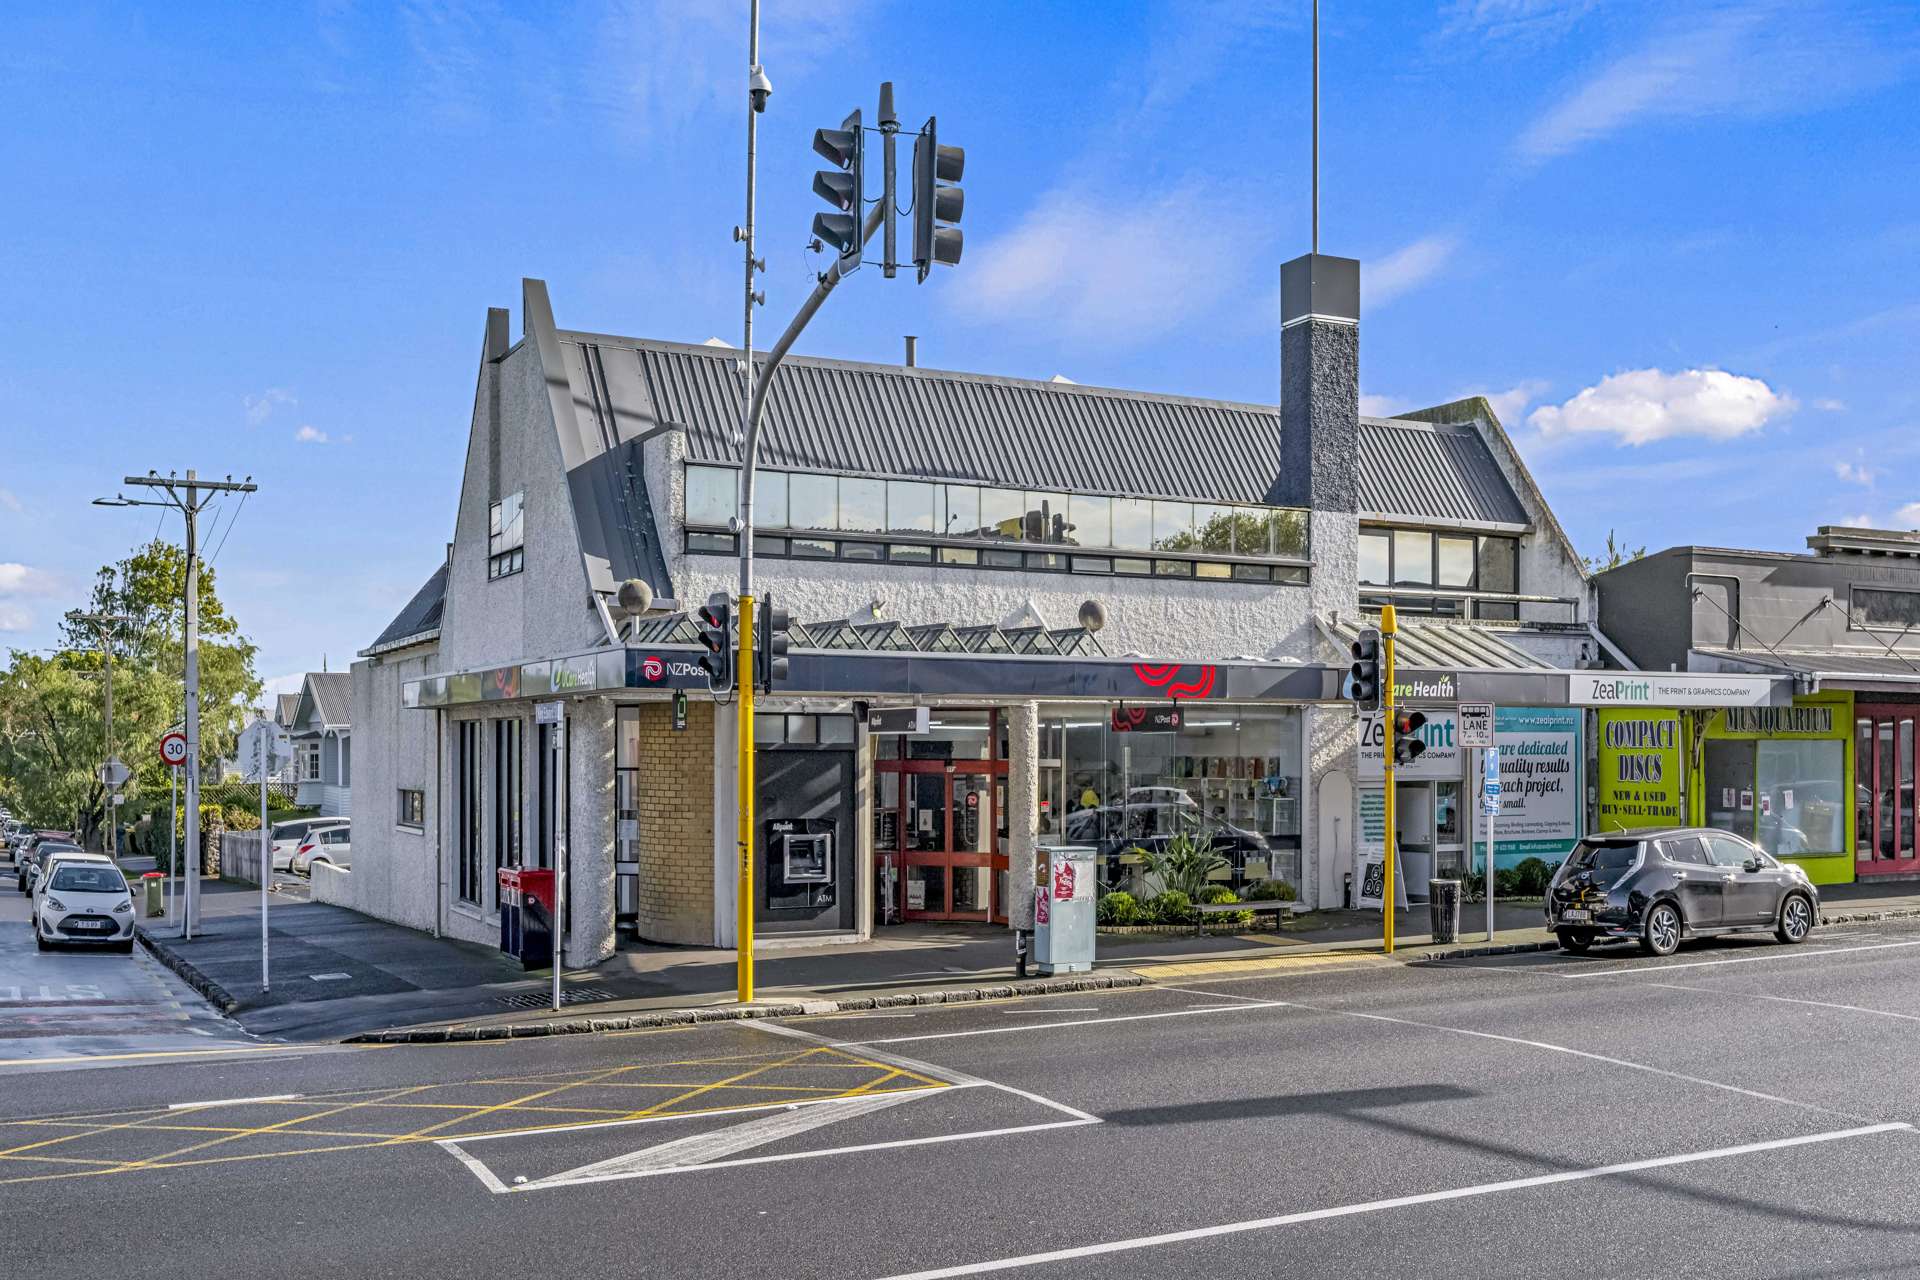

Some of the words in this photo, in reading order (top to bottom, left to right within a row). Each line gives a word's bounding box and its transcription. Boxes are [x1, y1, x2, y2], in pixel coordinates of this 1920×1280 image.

[1592, 680, 1649, 700] ZealPrint
[1658, 687, 1669, 695] THE
[1670, 687, 1687, 696] PRINT
[1688, 688, 1692, 696] &
[1693, 688, 1721, 697] GRAPHICS
[1722, 688, 1750, 697] COMPANY
[1463, 720, 1488, 730] LANE
[1726, 706, 1833, 736] MUSIQUARIUM
[1606, 720, 1675, 749] COMPACT
[168, 744, 182, 755] 30
[1499, 744, 1517, 755] are
[1518, 740, 1568, 755] dedicated
[1499, 759, 1533, 778] uality
[1535, 758, 1569, 774] results
[1617, 754, 1662, 783] DISCS
[1613, 790, 1630, 800] NEW
[1634, 791, 1640, 801] &
[1643, 791, 1666, 802] USED
